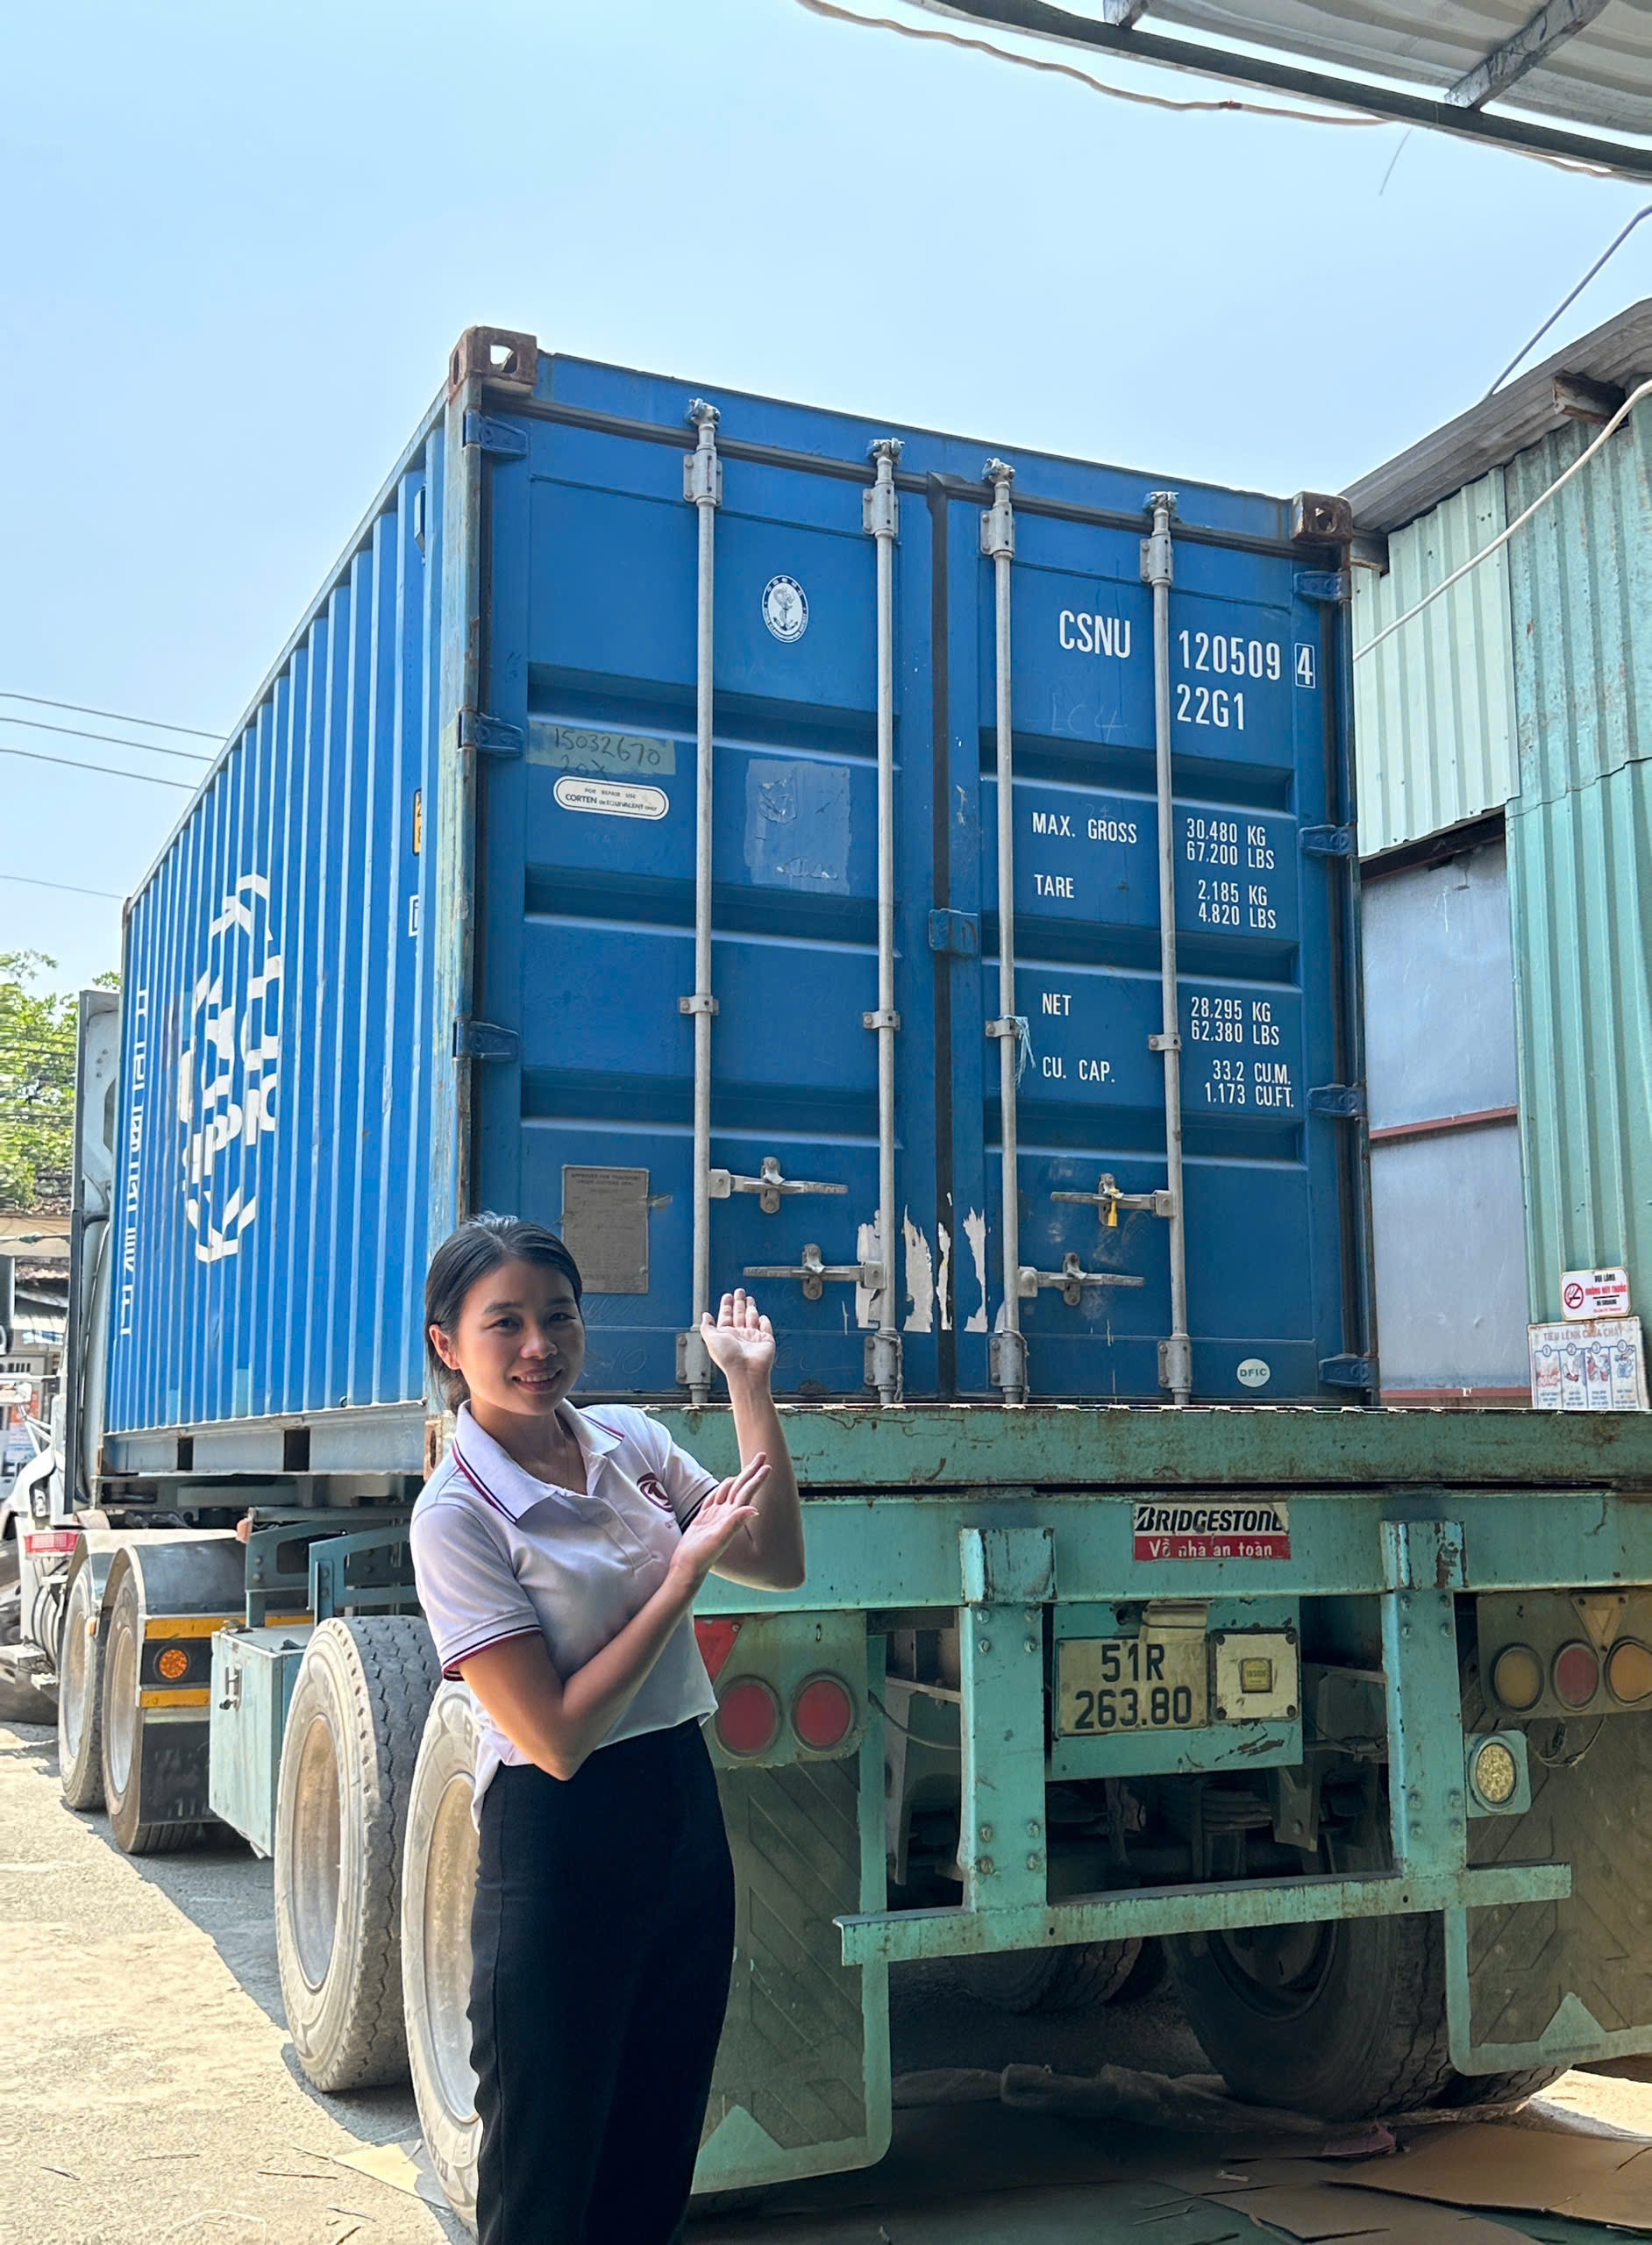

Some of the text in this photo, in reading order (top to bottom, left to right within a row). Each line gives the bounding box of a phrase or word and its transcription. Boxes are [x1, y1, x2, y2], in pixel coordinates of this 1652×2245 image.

[1058, 609, 1131, 659] CSNU
[1178, 630, 1314, 685] 120509 4
[1177, 684, 1244, 731] 22G1
[566, 794, 597, 805] CORTEN
[1032, 811, 1076, 837] MAX.
[1087, 819, 1137, 845] GROSS
[1247, 826, 1266, 847] KG
[1248, 848, 1275, 871] LBS
[1035, 874, 1075, 899] TARE
[1249, 885, 1268, 907] KG
[1250, 909, 1277, 930] LBS
[1042, 993, 1072, 1016] NET
[1252, 1001, 1271, 1023] KG
[1253, 1024, 1280, 1046] LBS
[1043, 1056, 1115, 1083] CU. CAP.
[1212, 1060, 1292, 1086] 33.2 CU.M.
[1255, 1086, 1294, 1108] CU.FT.
[1240, 1368, 1268, 1377] DFIC
[1178, 1539, 1207, 1557] nhà
[1213, 1544, 1231, 1557] an
[1237, 1541, 1272, 1557] toàn
[1101, 1643, 1165, 1683] 51R
[1074, 1686, 1193, 1729] 263.80
